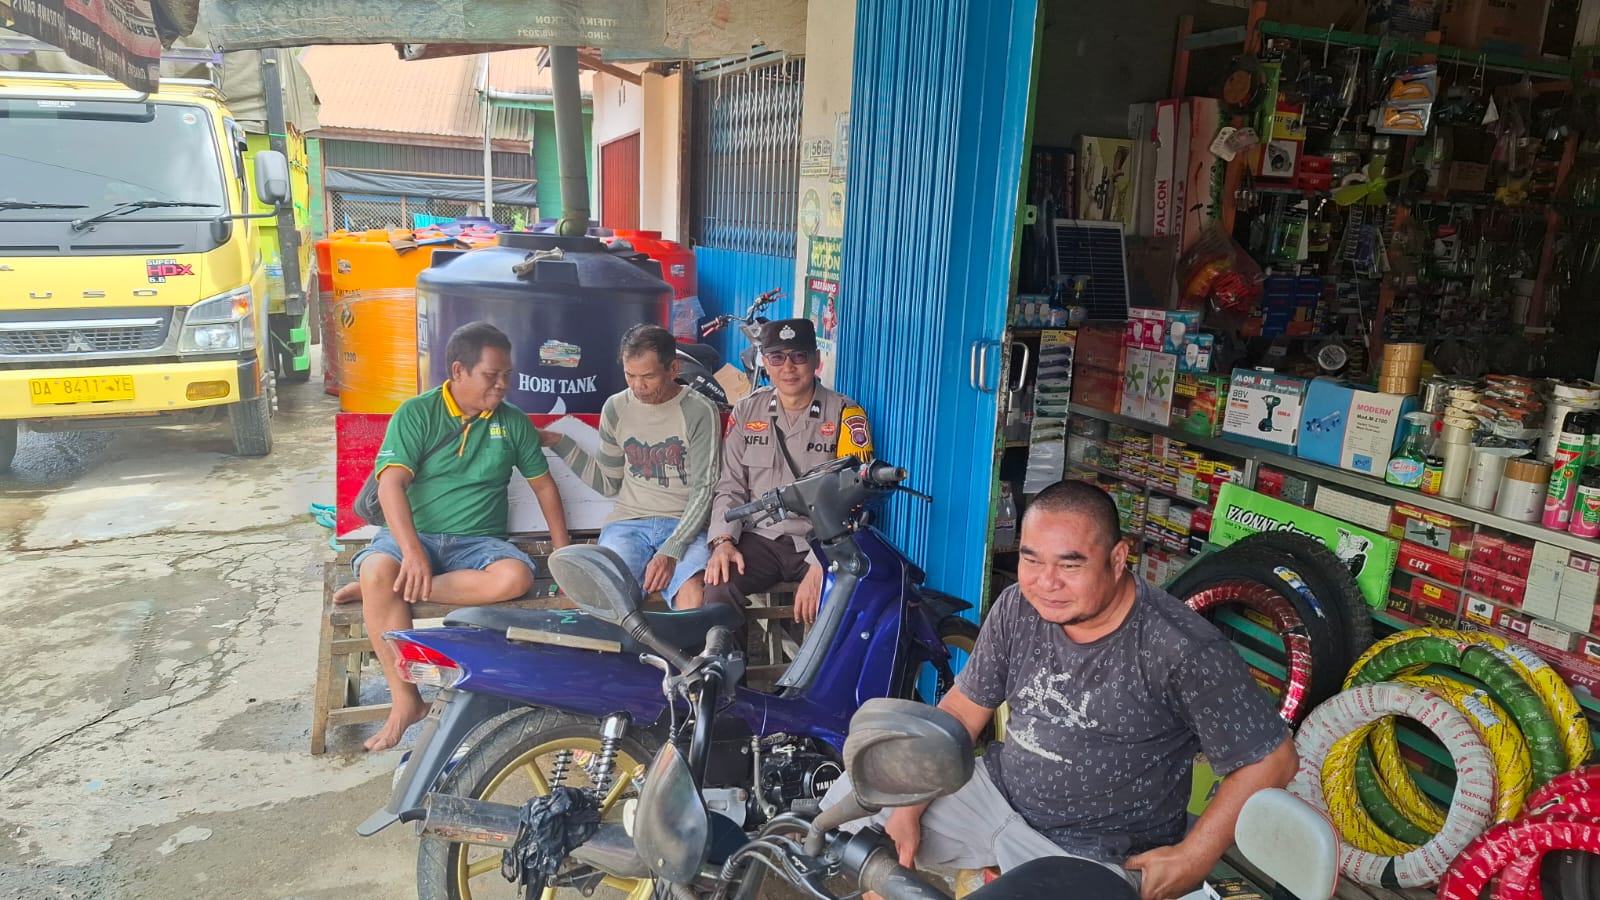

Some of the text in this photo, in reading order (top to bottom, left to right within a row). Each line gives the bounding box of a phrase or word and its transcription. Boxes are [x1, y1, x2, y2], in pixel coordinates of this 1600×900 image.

[1156, 180, 1167, 237] FALCON
[811, 253, 840, 270] KUPON
[149, 276, 165, 284] 6.6
[32, 377, 132, 395] DA 8411 YE
[518, 372, 597, 394] HOBI TANK
[1356, 404, 1392, 416] MODERN
[1226, 504, 1279, 533] INNOVA
[1408, 557, 1432, 572] CRT
[1570, 673, 1597, 687] CRT
